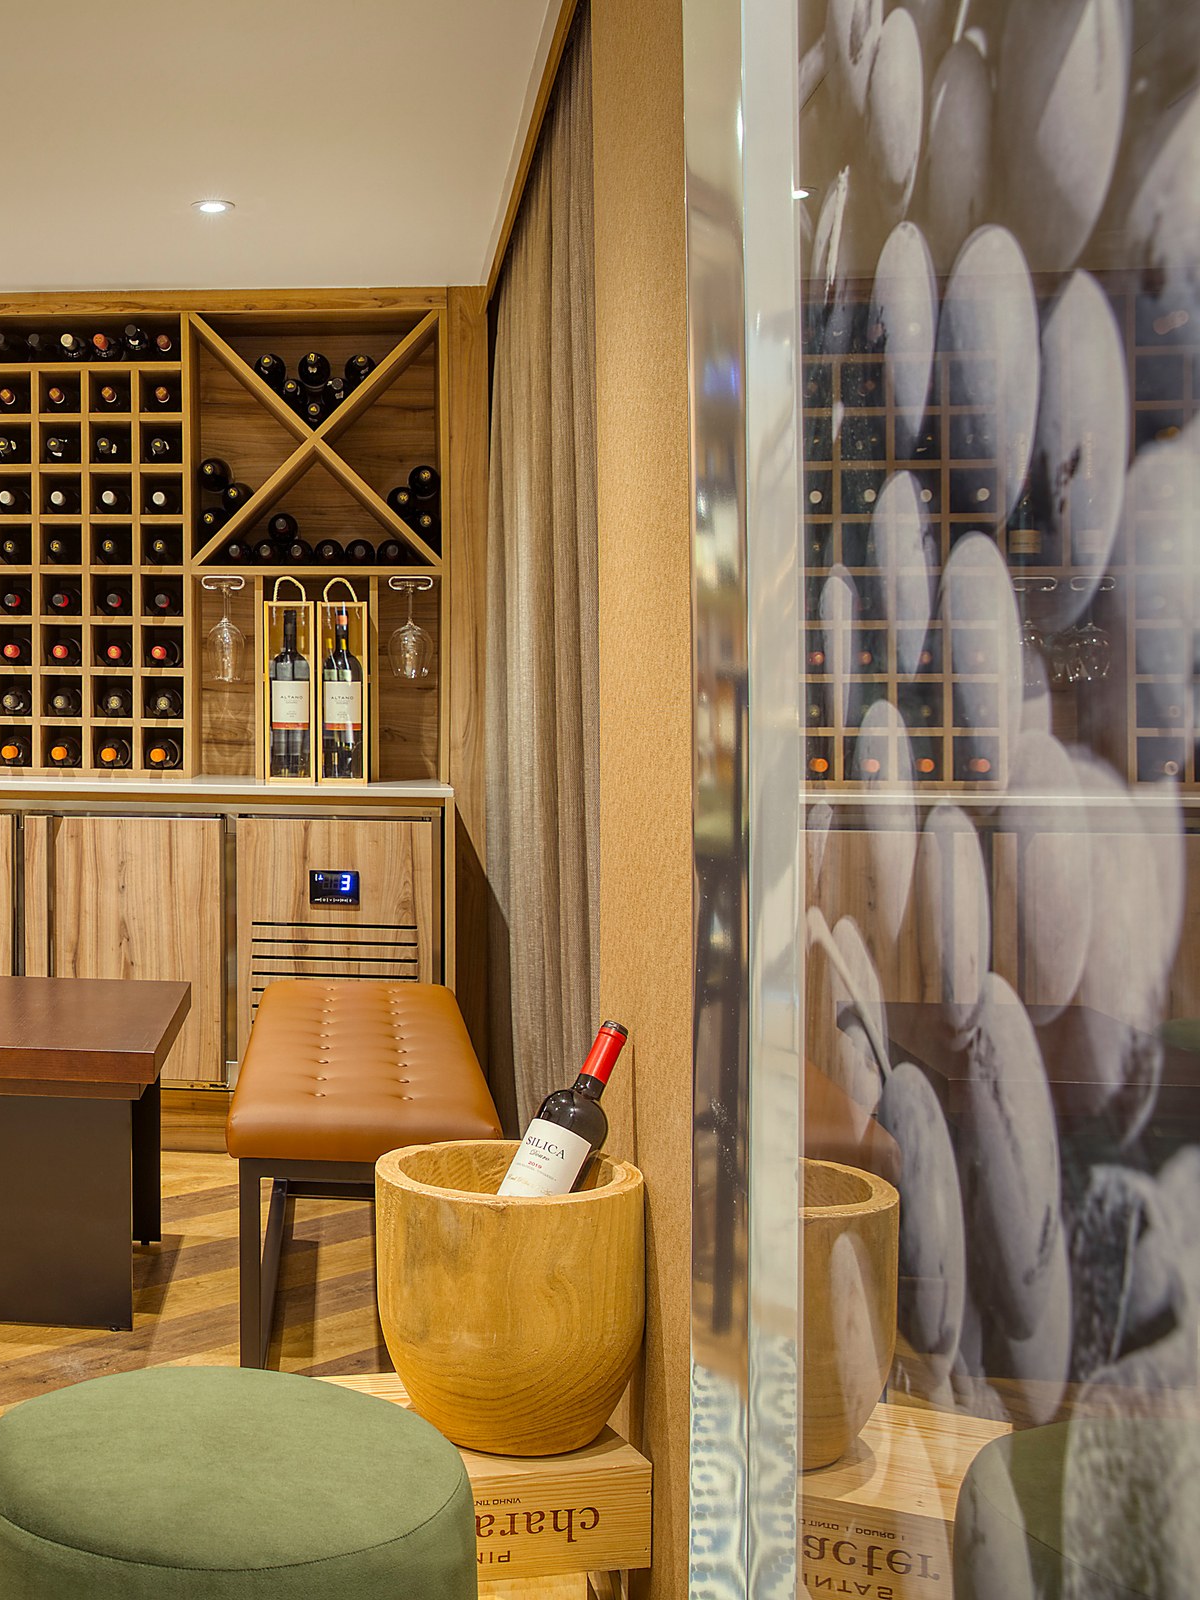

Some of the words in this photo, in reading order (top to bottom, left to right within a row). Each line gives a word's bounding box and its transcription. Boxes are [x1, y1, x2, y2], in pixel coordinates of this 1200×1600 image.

[341, 874, 351, 891] 3
[525, 1135, 566, 1161] SILICA
[492, 1498, 521, 1506] VINHO
[475, 1506, 600, 1543] chara
